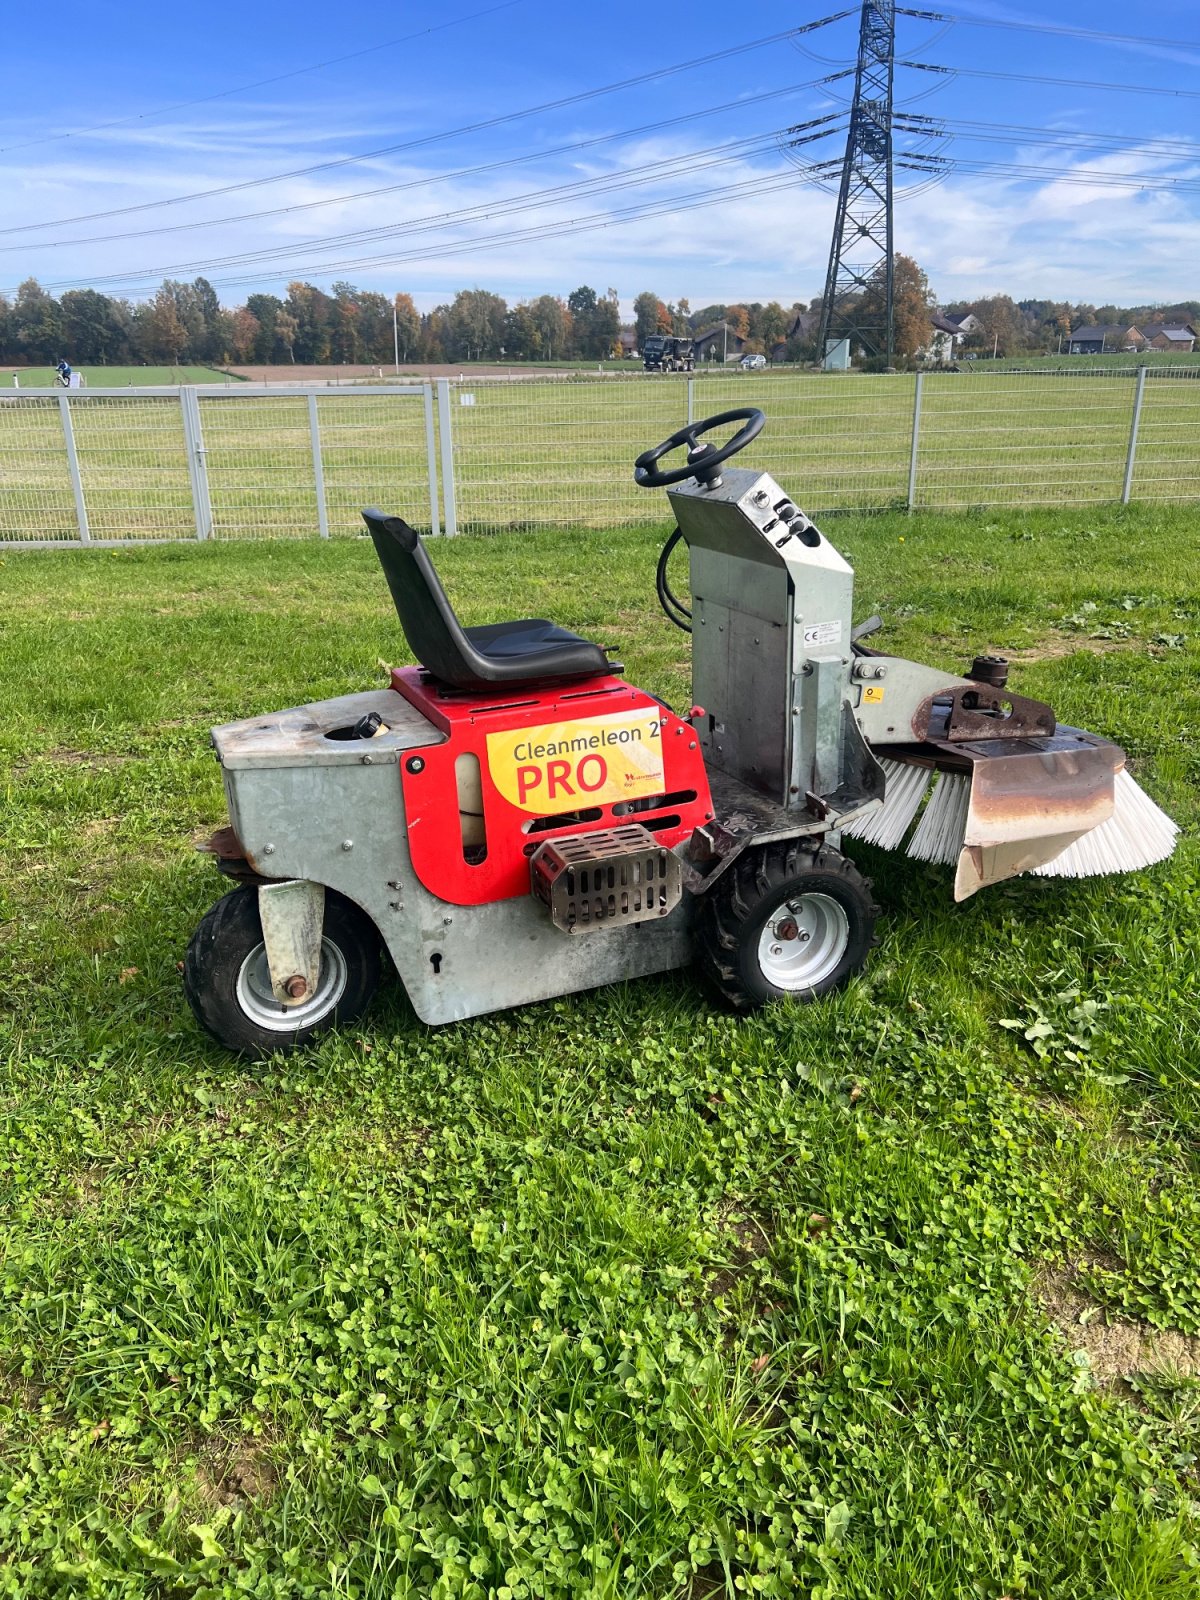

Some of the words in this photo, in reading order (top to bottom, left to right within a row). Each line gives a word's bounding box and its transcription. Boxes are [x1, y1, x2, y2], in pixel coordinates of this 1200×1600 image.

[514, 728, 642, 761] Cleanmeleon
[649, 721, 660, 738] 2
[517, 753, 608, 805] PRO
